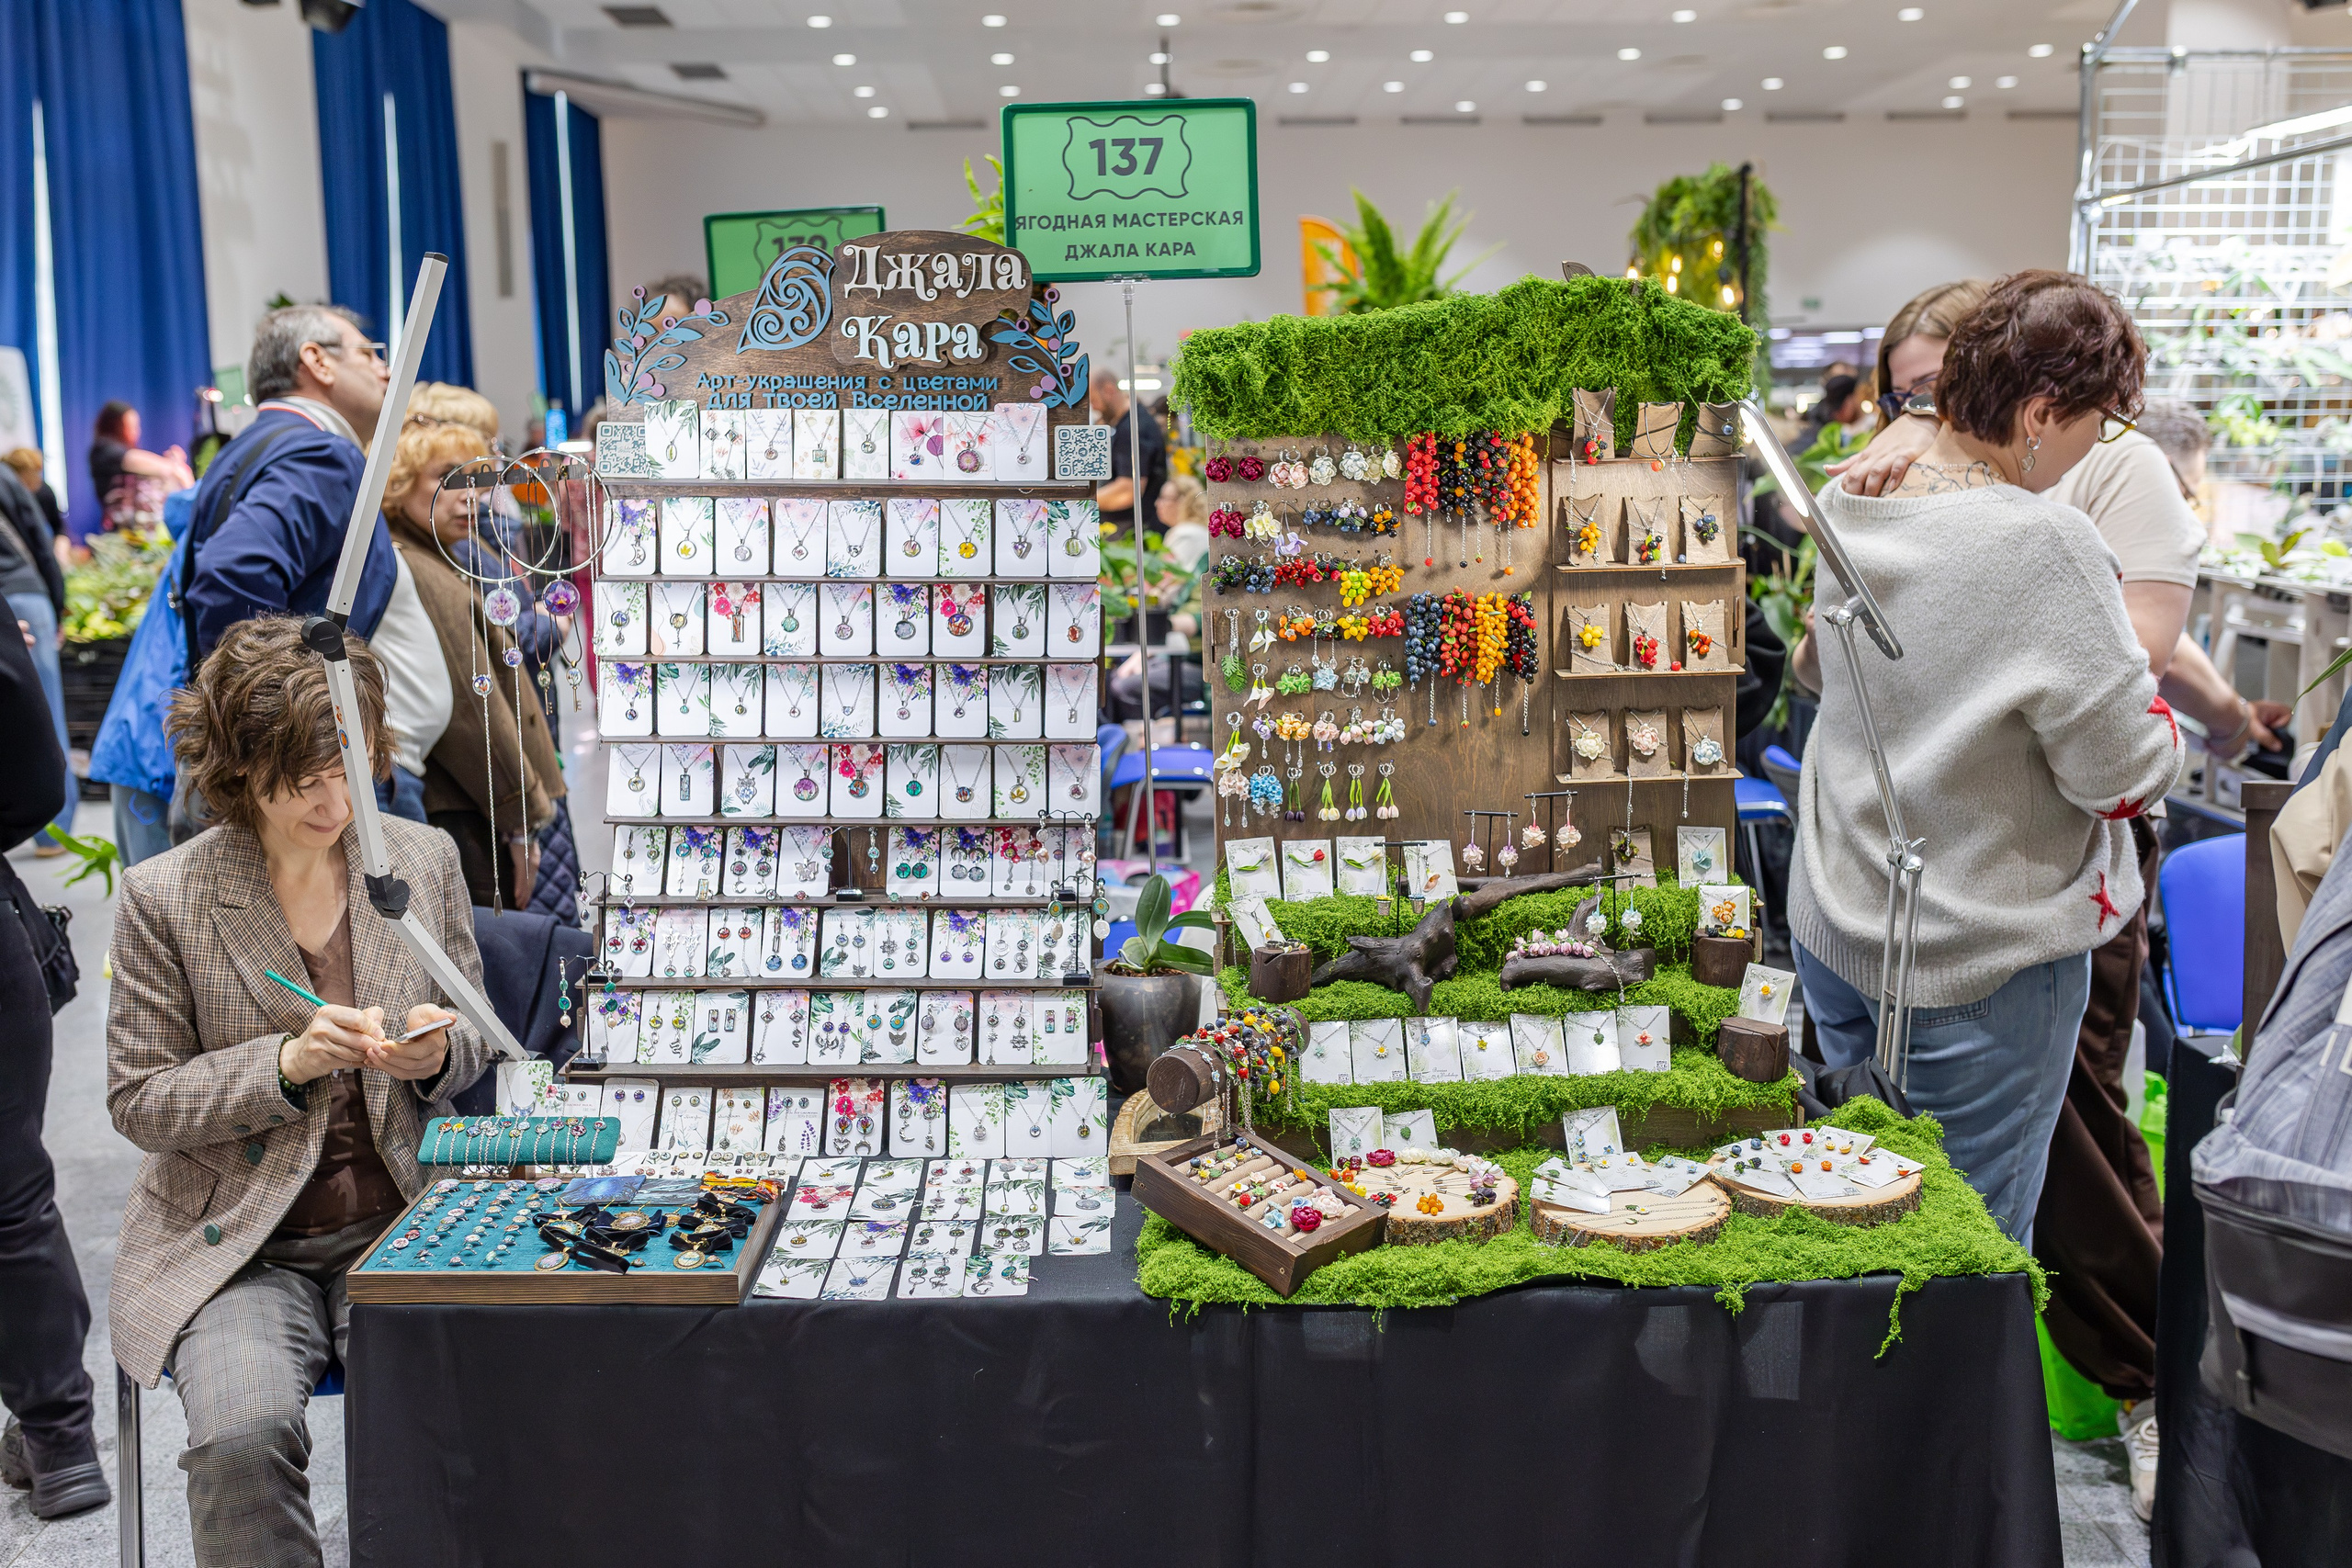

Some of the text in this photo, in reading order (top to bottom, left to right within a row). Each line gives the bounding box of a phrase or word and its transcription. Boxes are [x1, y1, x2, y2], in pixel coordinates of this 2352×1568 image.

[1089, 137, 1164, 176] 137
[1015, 210, 1244, 232] ЯГОДНАЯ МАСТЕРСКАЯ
[1065, 242, 1196, 262] ДЖАЛА КАРА
[842, 244, 1027, 302] Джала
[841, 314, 983, 369] Кара
[695, 372, 998, 393] Арт-украшения с цветами
[706, 390, 988, 411] для твоей Вселенной
